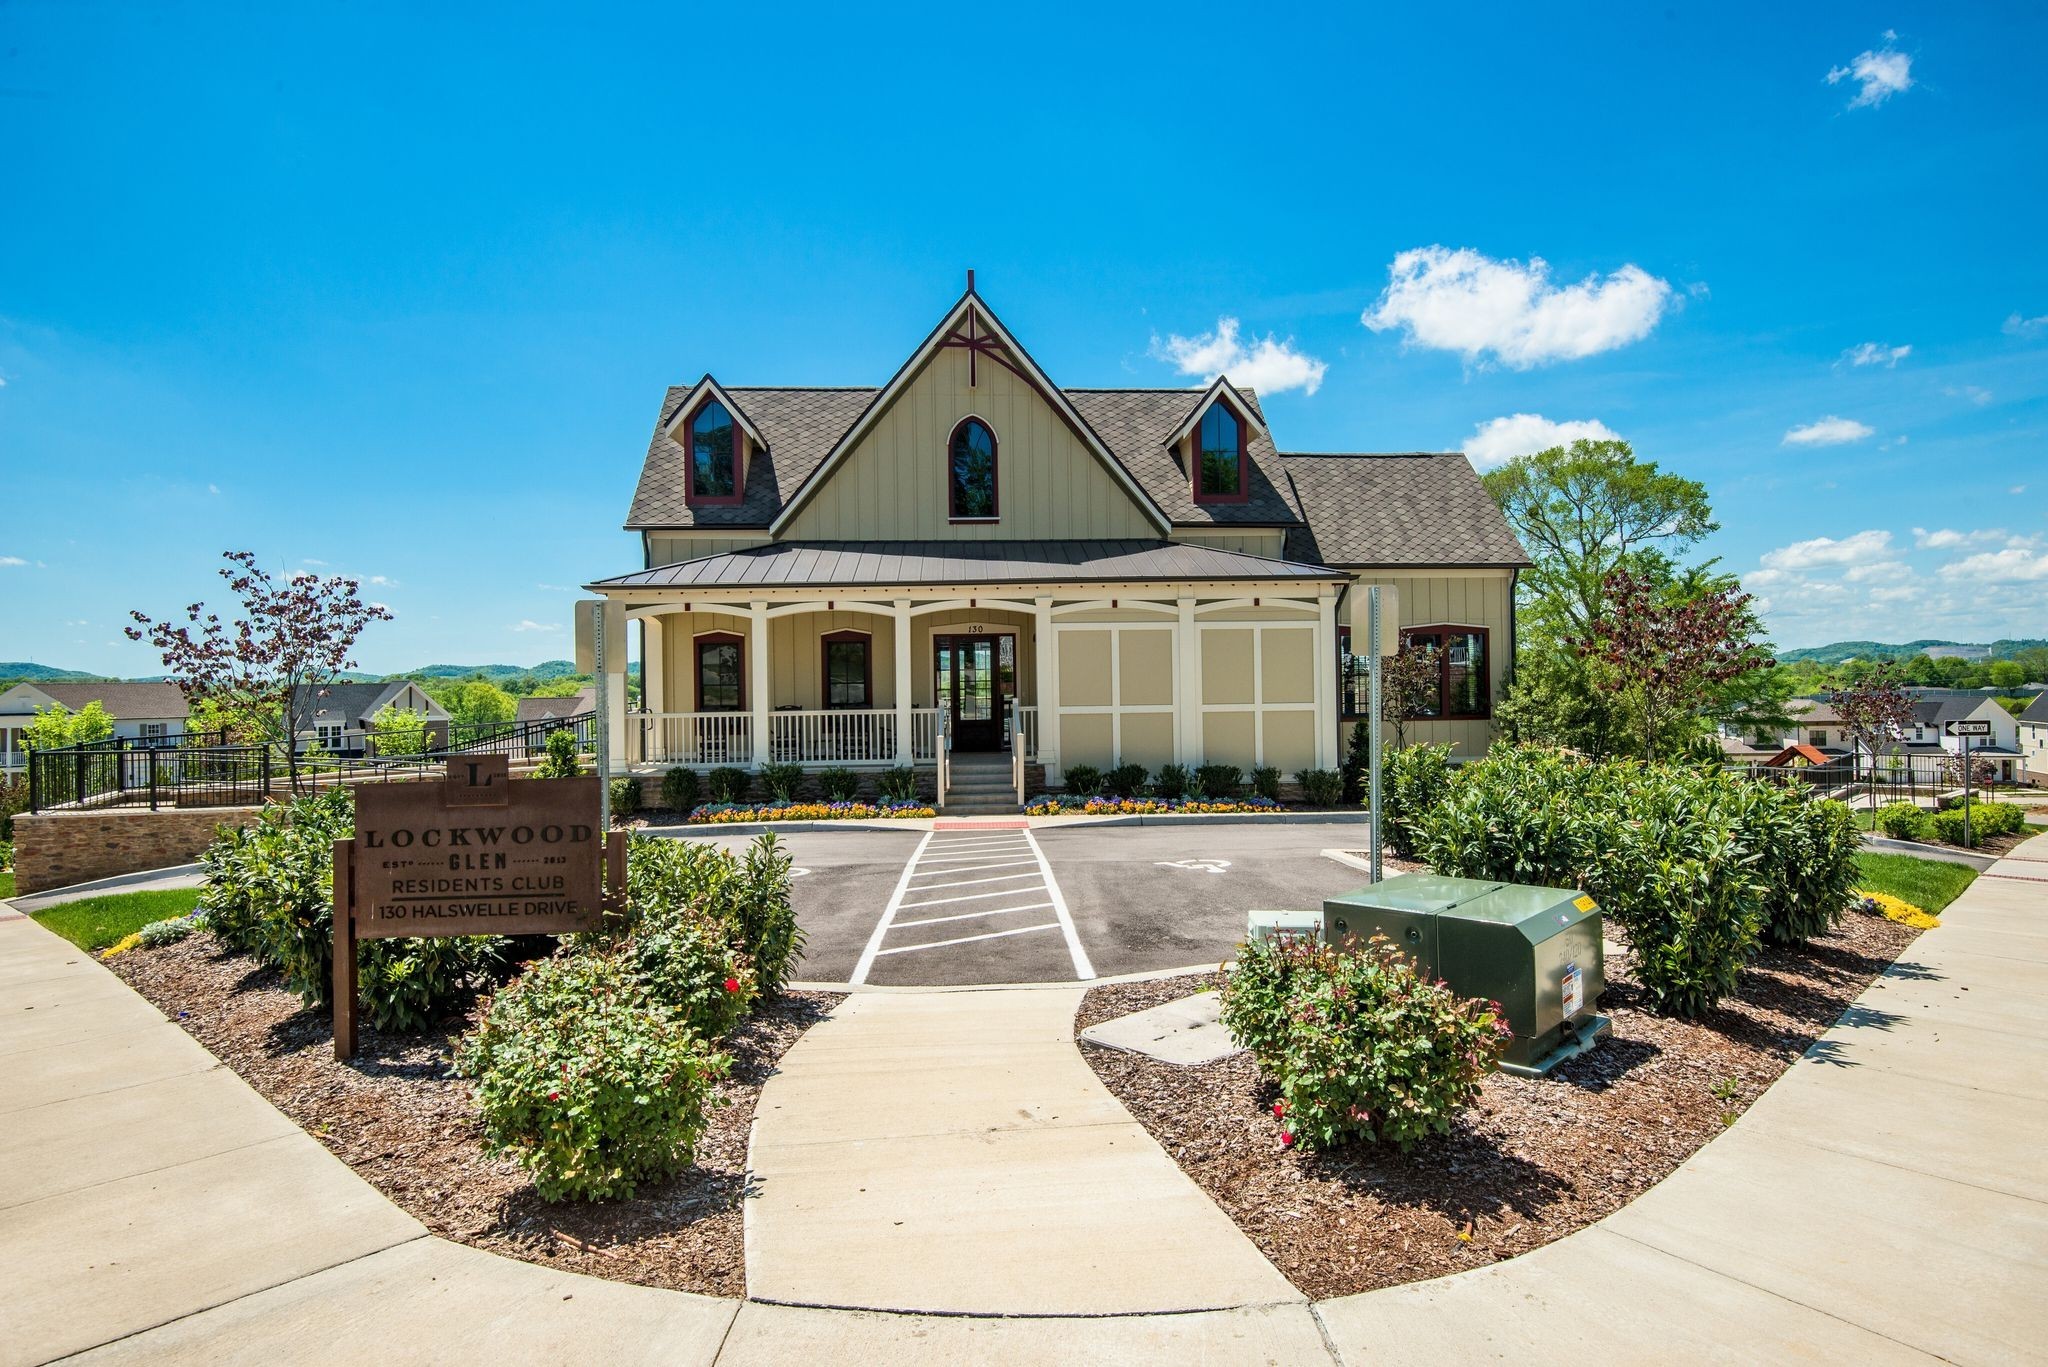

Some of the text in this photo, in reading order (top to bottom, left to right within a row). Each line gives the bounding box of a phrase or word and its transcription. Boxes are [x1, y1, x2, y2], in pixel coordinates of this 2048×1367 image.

[968, 625, 983, 633] 130
[467, 763, 492, 787] L
[364, 824, 593, 849] LOCKWOOD
[449, 853, 507, 871] GLEN
[543, 856, 567, 865] 2013
[392, 875, 565, 894] RESIDENTS CLUB
[379, 900, 578, 920] 130 HALSWELLE DRIVE
